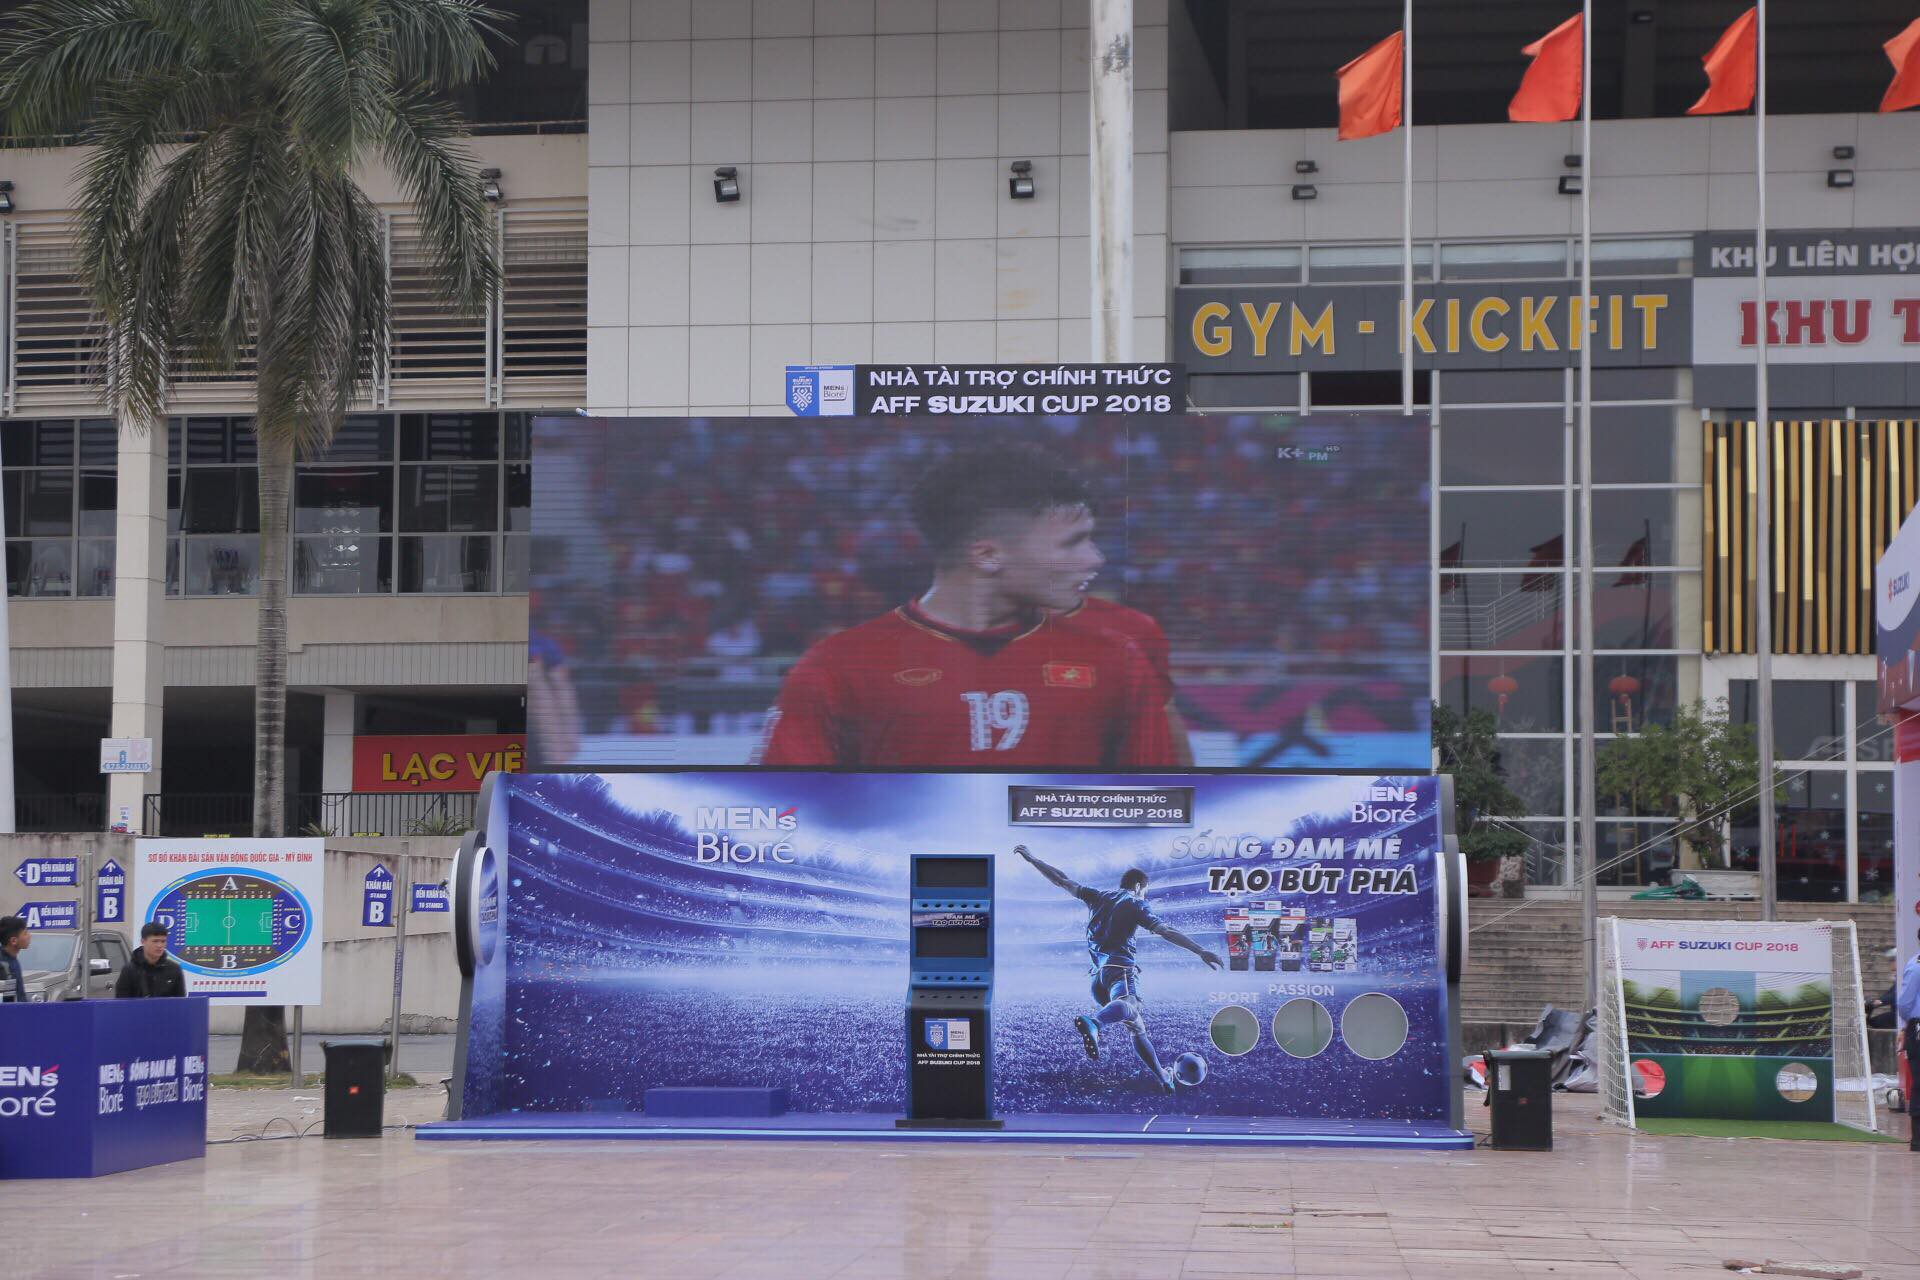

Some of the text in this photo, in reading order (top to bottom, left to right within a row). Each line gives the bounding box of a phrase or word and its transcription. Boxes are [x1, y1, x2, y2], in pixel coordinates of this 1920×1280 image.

[1711, 240, 1920, 271] KHU LIÊN HỢ
[1192, 293, 1669, 356] GYM - KICKFIT
[1739, 299, 1872, 345] KHU
[870, 366, 1171, 390] NHÀ TÀI TRỢ CHÍNH THỨC
[870, 395, 1171, 414] AFF SUZUKI CUP 2018
[1278, 447, 1304, 458] K+
[1309, 452, 1328, 461] PM
[960, 690, 1030, 751] 19
[382, 752, 457, 786] LẠC
[1035, 793, 1167, 804] NHÀ TÀI TRỢ CHÍNH THỨC
[1020, 807, 1183, 819] AFF SUZUKI CUP 2018
[1351, 803, 1417, 823] Bioré
[696, 832, 795, 864] Bioré
[1169, 829, 1402, 860] SỐNG ĐAM MÊ
[26, 863, 41, 884] D
[221, 876, 239, 891] A
[1208, 863, 1418, 896] TẠO BÚT PHÁ
[366, 879, 392, 891] KHÁN ĐÀI
[416, 887, 425, 899] ĐẾN
[426, 887, 439, 899] KHÁN
[26, 906, 41, 928] A
[104, 896, 118, 919] B
[369, 901, 384, 923] B
[158, 915, 175, 930] D
[284, 914, 301, 929] C
[1650, 940, 1799, 952] AFF SUZUKI CUP 2018
[221, 954, 237, 969] B
[1208, 991, 1260, 1003] SPORT
[1268, 984, 1335, 996] PASSION
[99, 1085, 124, 1115] Bioré
[183, 1075, 204, 1104] Bioré
